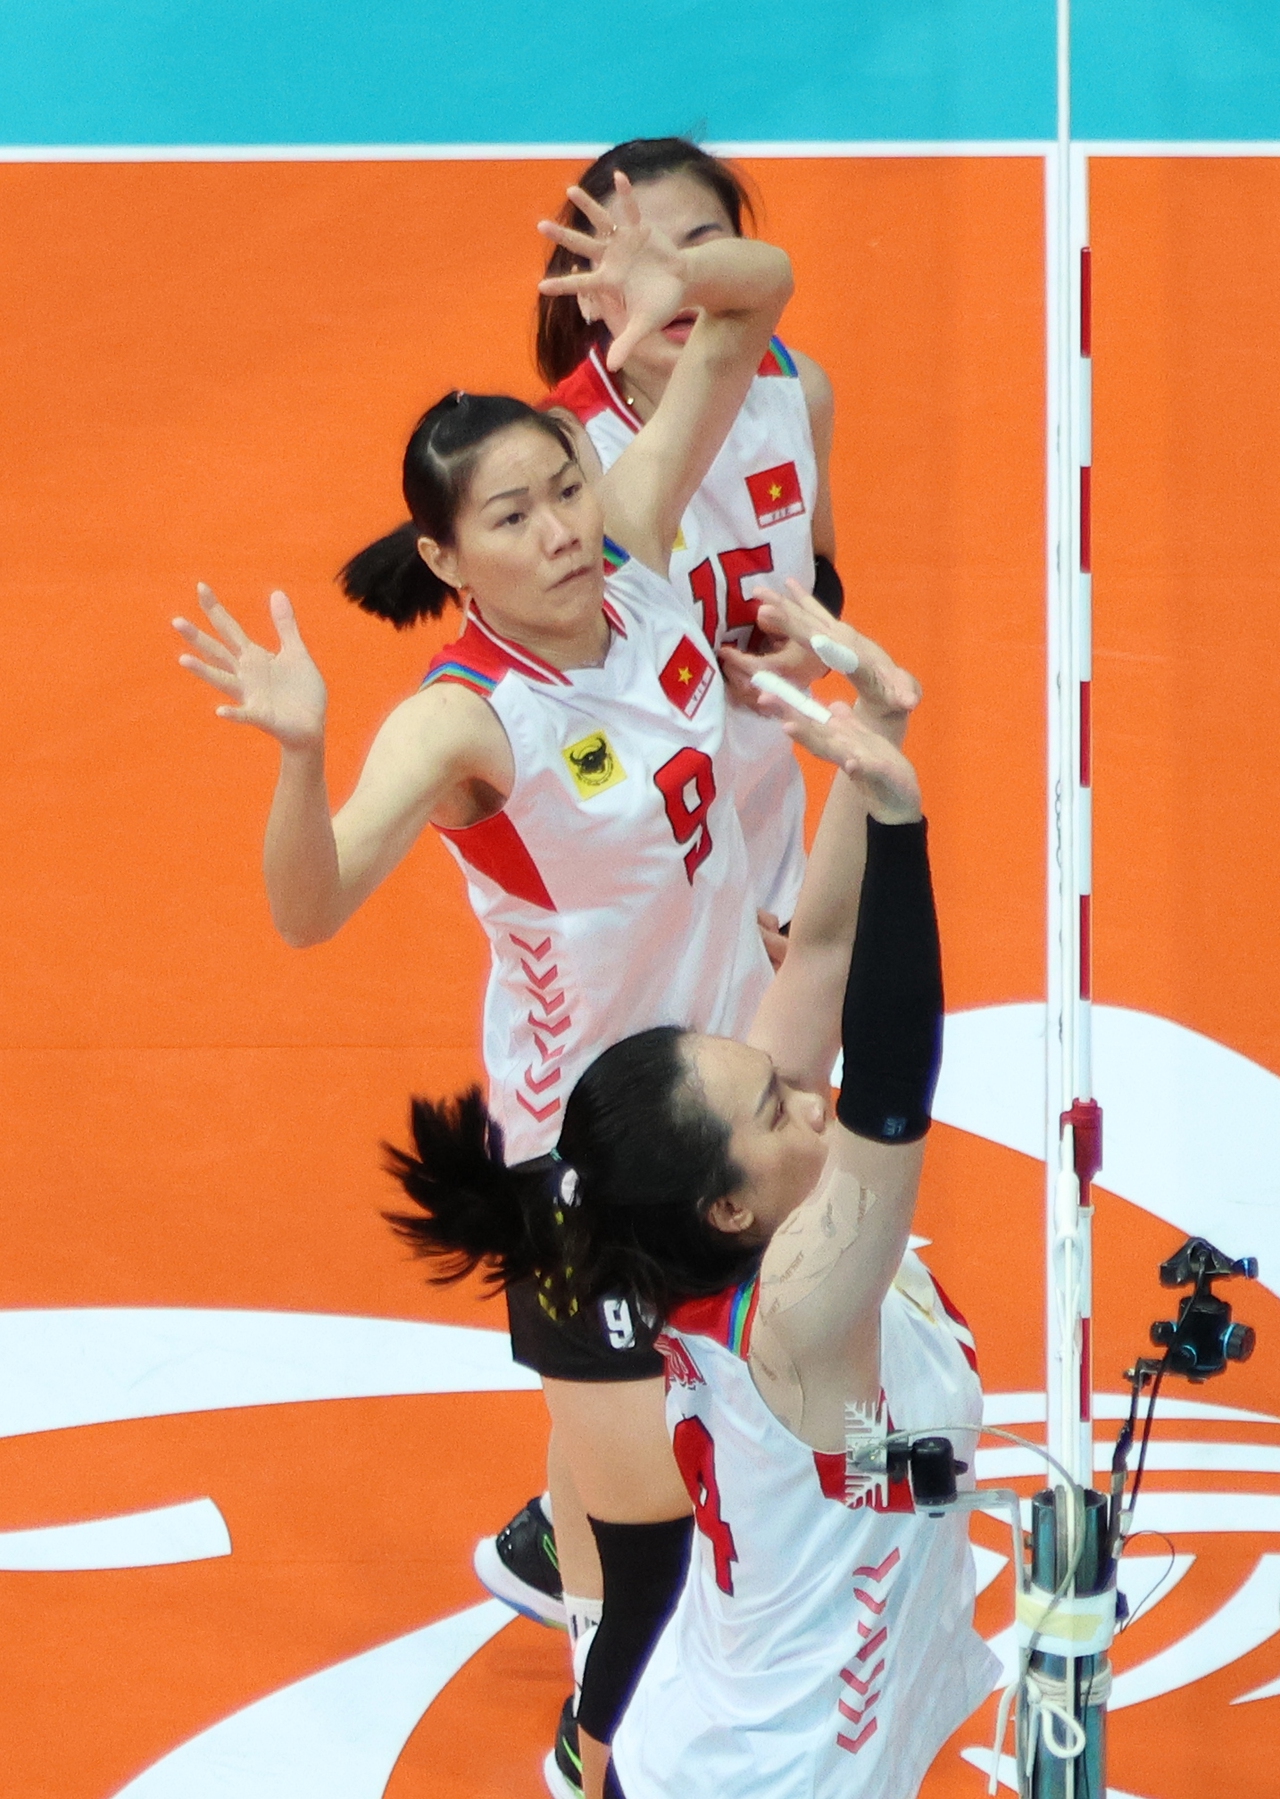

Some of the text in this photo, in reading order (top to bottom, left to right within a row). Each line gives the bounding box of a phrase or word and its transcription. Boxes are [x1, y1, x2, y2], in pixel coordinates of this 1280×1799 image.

[688, 542, 774, 656] 15
[653, 746, 717, 886] 9
[603, 1298, 637, 1350] 9
